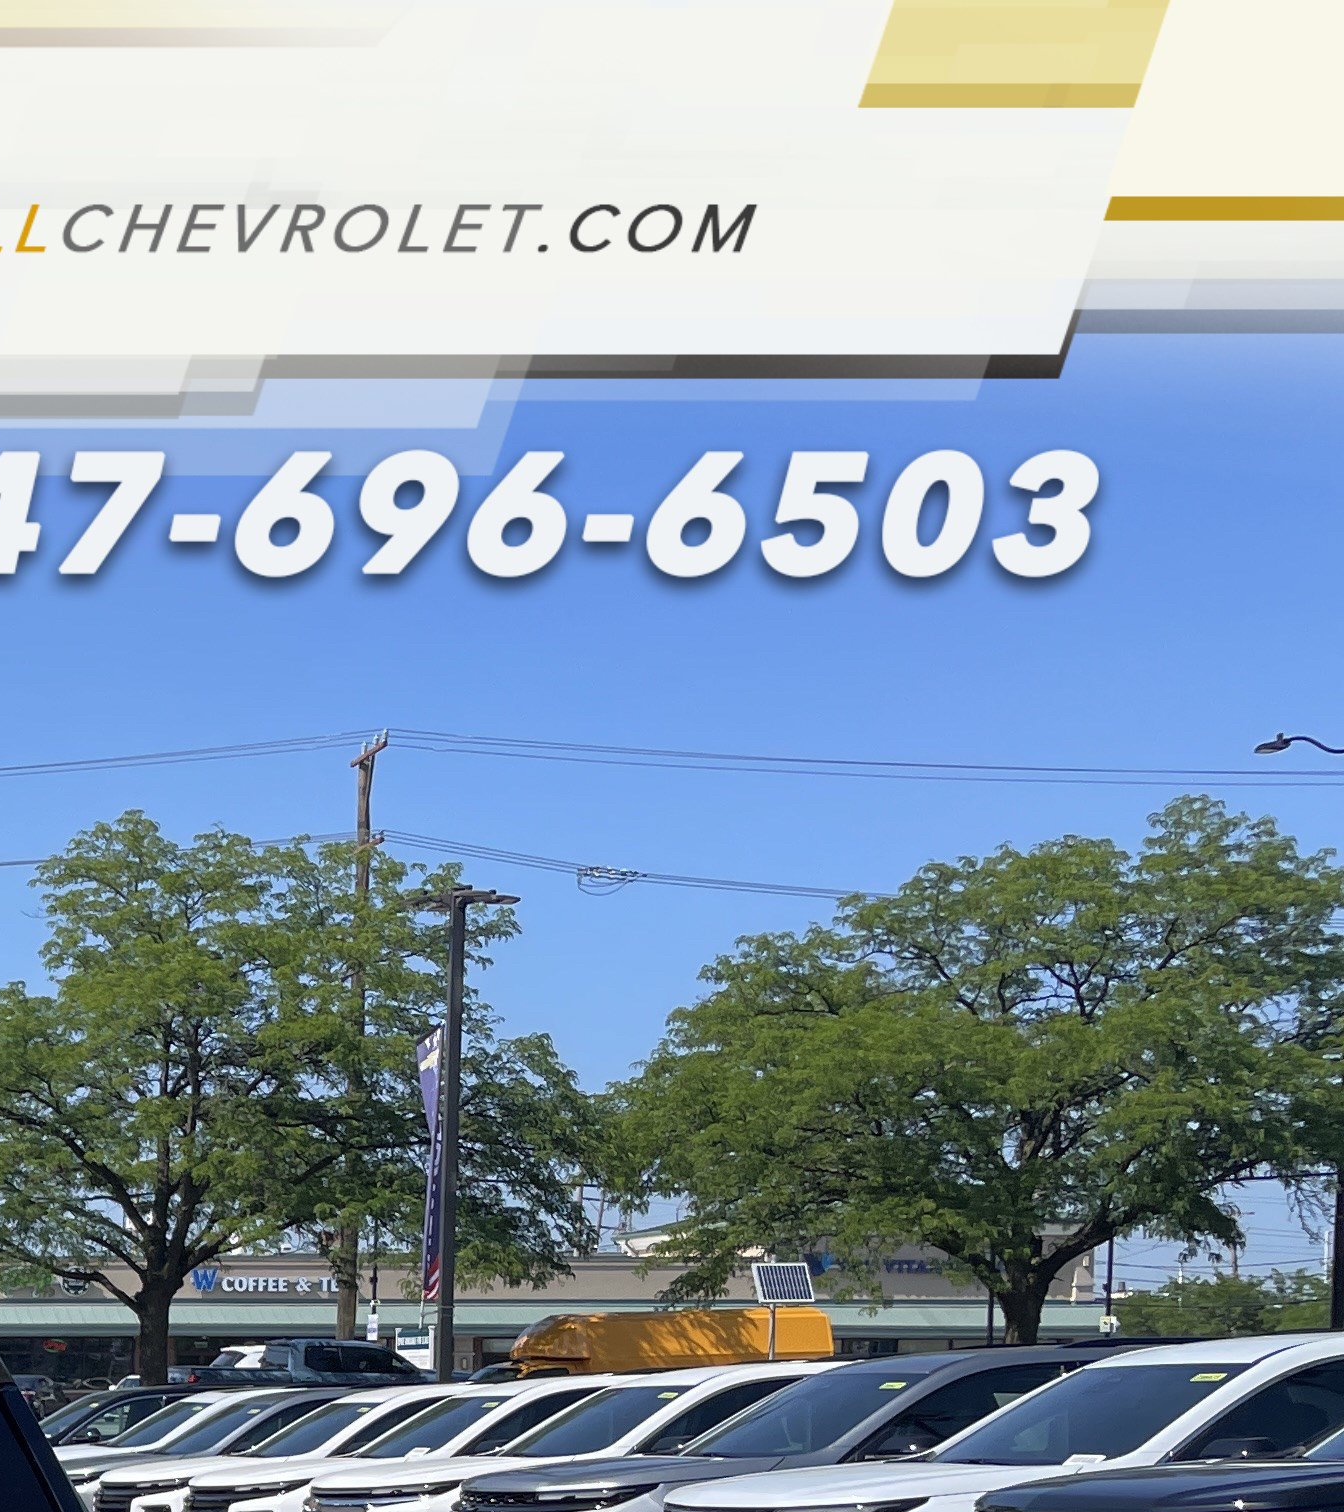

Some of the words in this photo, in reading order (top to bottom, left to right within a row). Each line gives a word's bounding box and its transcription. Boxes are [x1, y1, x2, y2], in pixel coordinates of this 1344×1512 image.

[221, 1277, 288, 1292] COFFEE
[295, 1276, 312, 1292] &
[319, 1277, 340, 1292] TE
